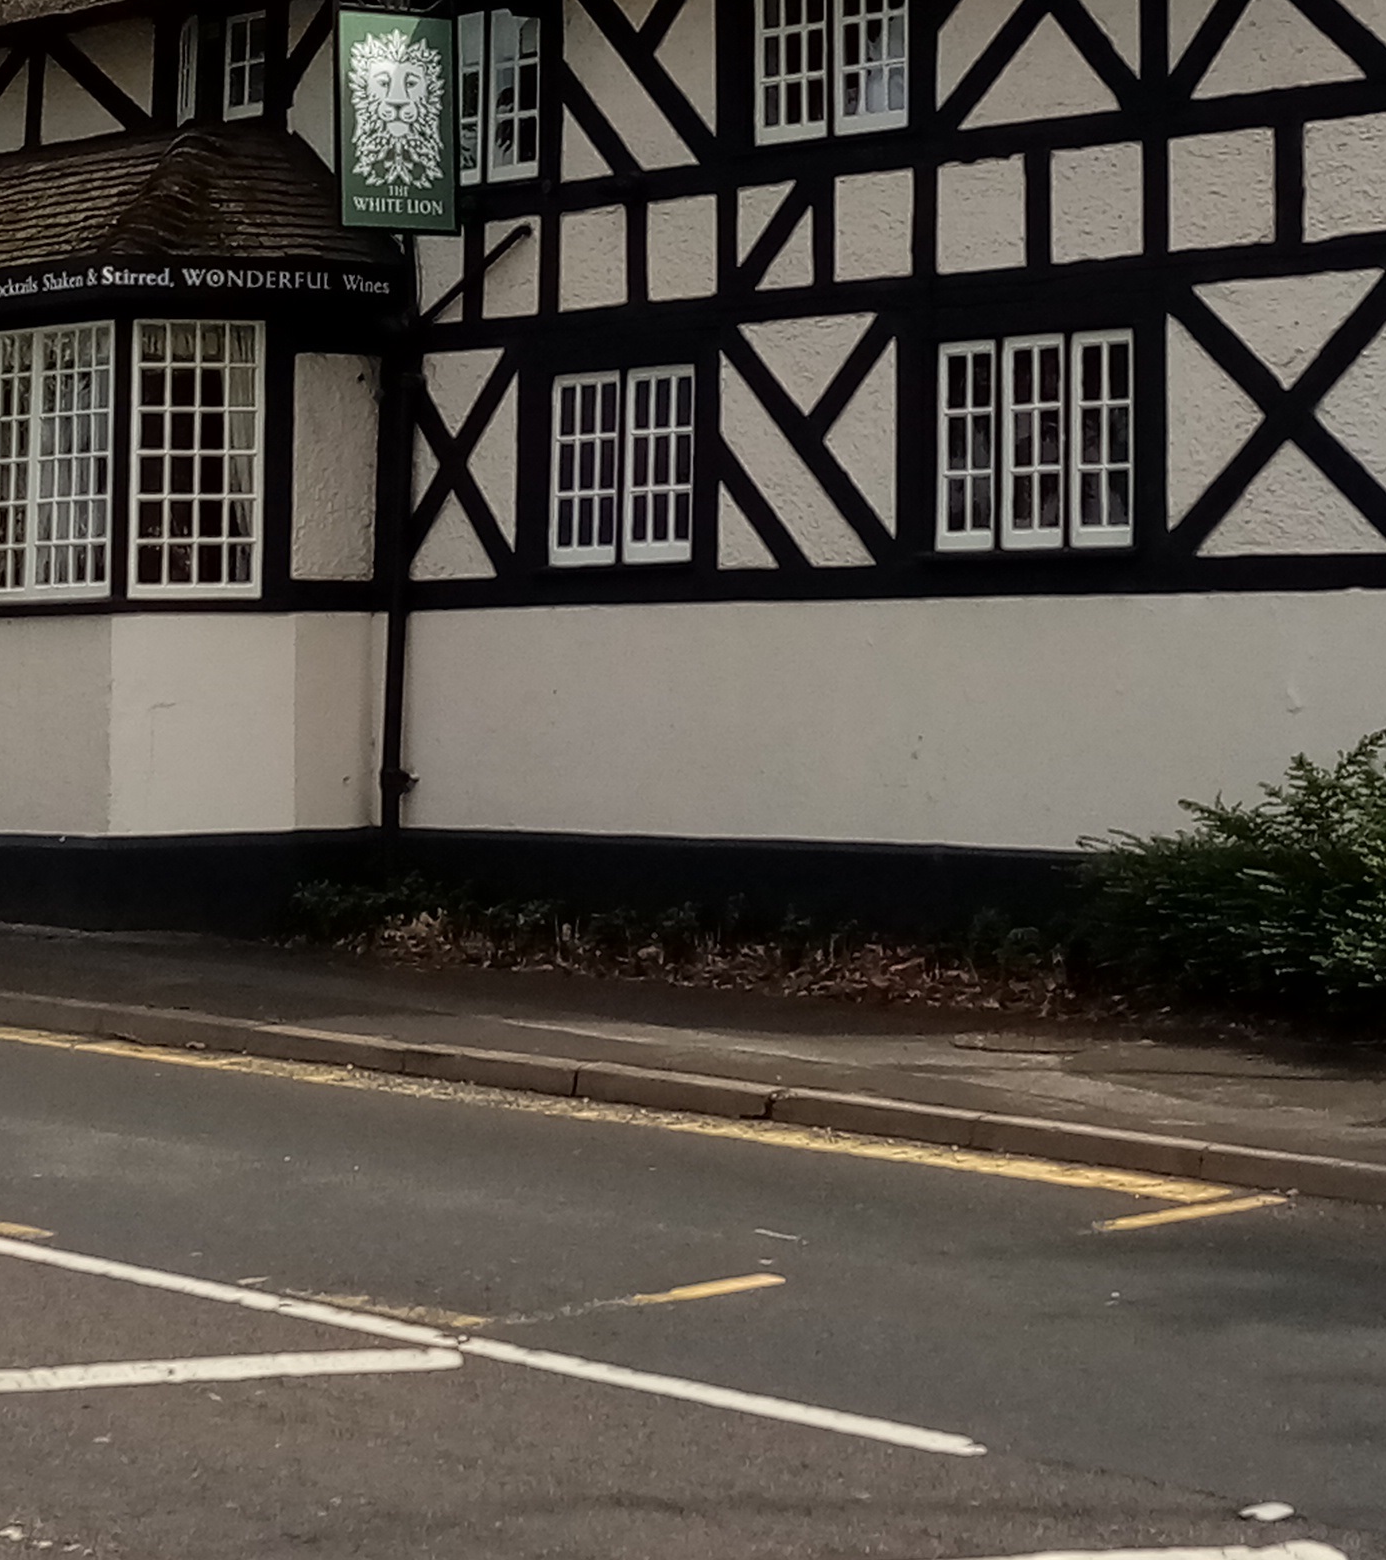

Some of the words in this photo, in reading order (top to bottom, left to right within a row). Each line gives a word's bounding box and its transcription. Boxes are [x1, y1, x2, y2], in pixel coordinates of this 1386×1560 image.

[388, 185, 409, 197] THE
[353, 196, 404, 213] WHITE
[407, 199, 444, 216] LION
[42, 270, 84, 292] Shaken
[86, 267, 99, 287] &
[181, 267, 332, 290] WONDERFUL
[342, 272, 390, 295] Wines
